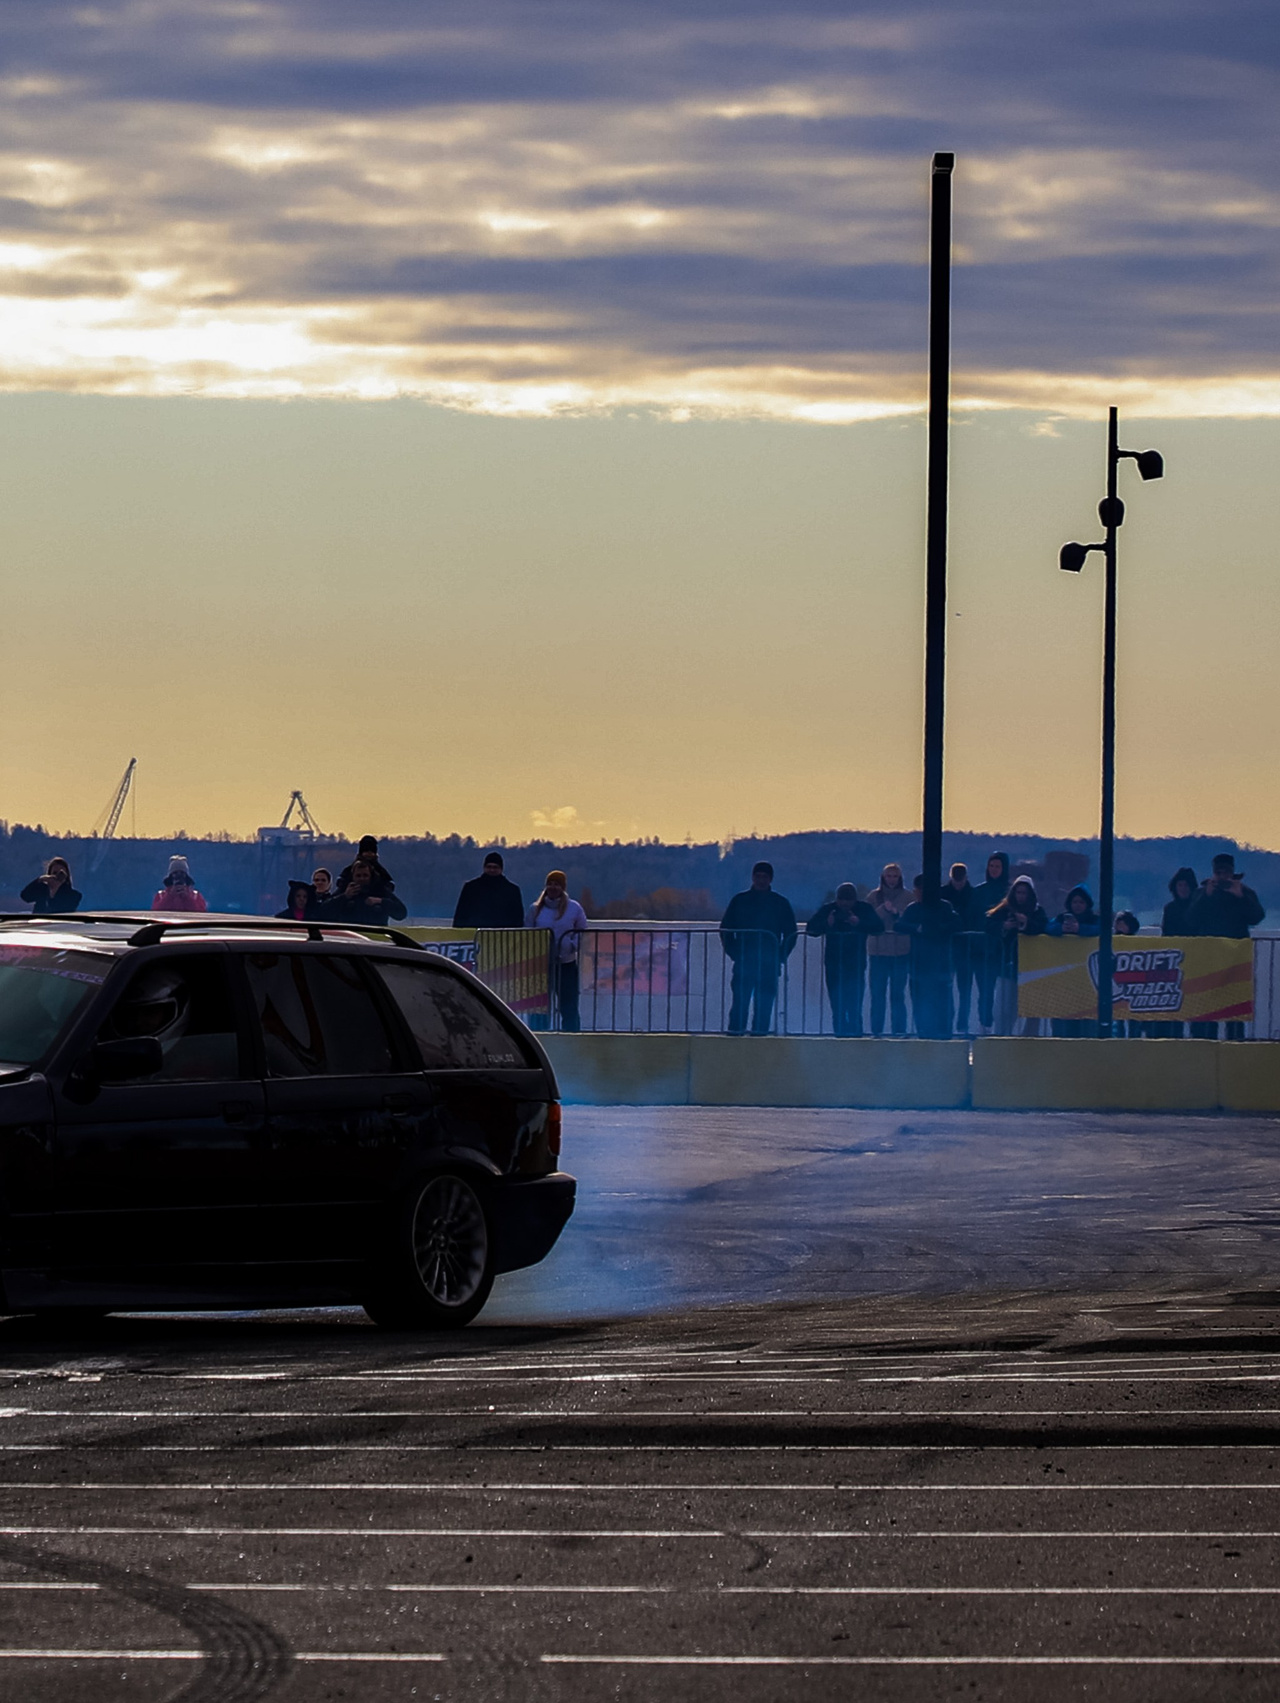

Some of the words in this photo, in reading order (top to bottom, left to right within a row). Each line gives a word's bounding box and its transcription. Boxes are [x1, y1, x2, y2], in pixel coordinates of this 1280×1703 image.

[1116, 953, 1179, 972] DRIFT
[1126, 982, 1175, 995] TRACK
[1132, 994, 1179, 1007] MODE
